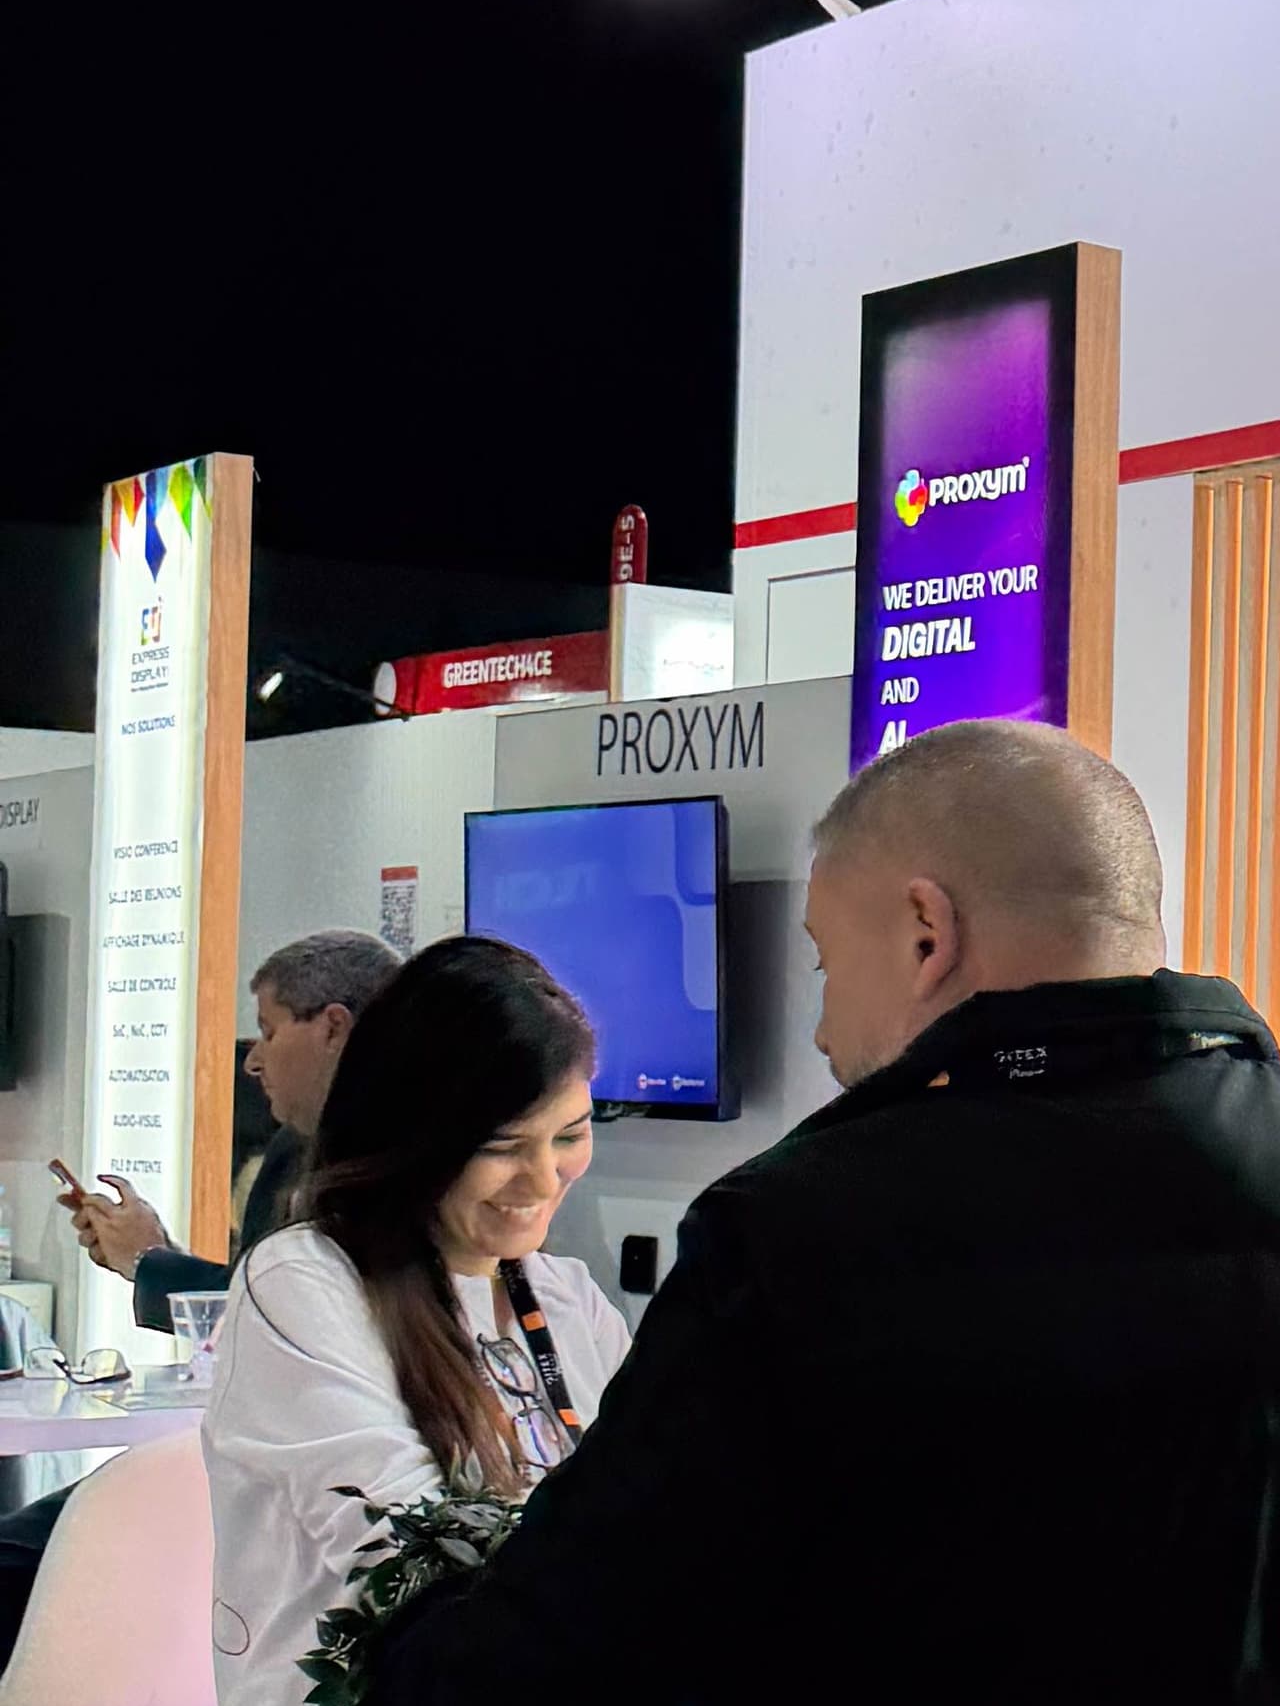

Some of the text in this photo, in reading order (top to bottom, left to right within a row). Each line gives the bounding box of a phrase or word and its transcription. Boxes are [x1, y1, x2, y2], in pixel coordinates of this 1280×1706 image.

[883, 564, 1038, 611] WE DELIVER YOUR
[881, 616, 976, 662] DIGITAL
[880, 676, 920, 705] AND
[597, 700, 765, 776] PROXYM
